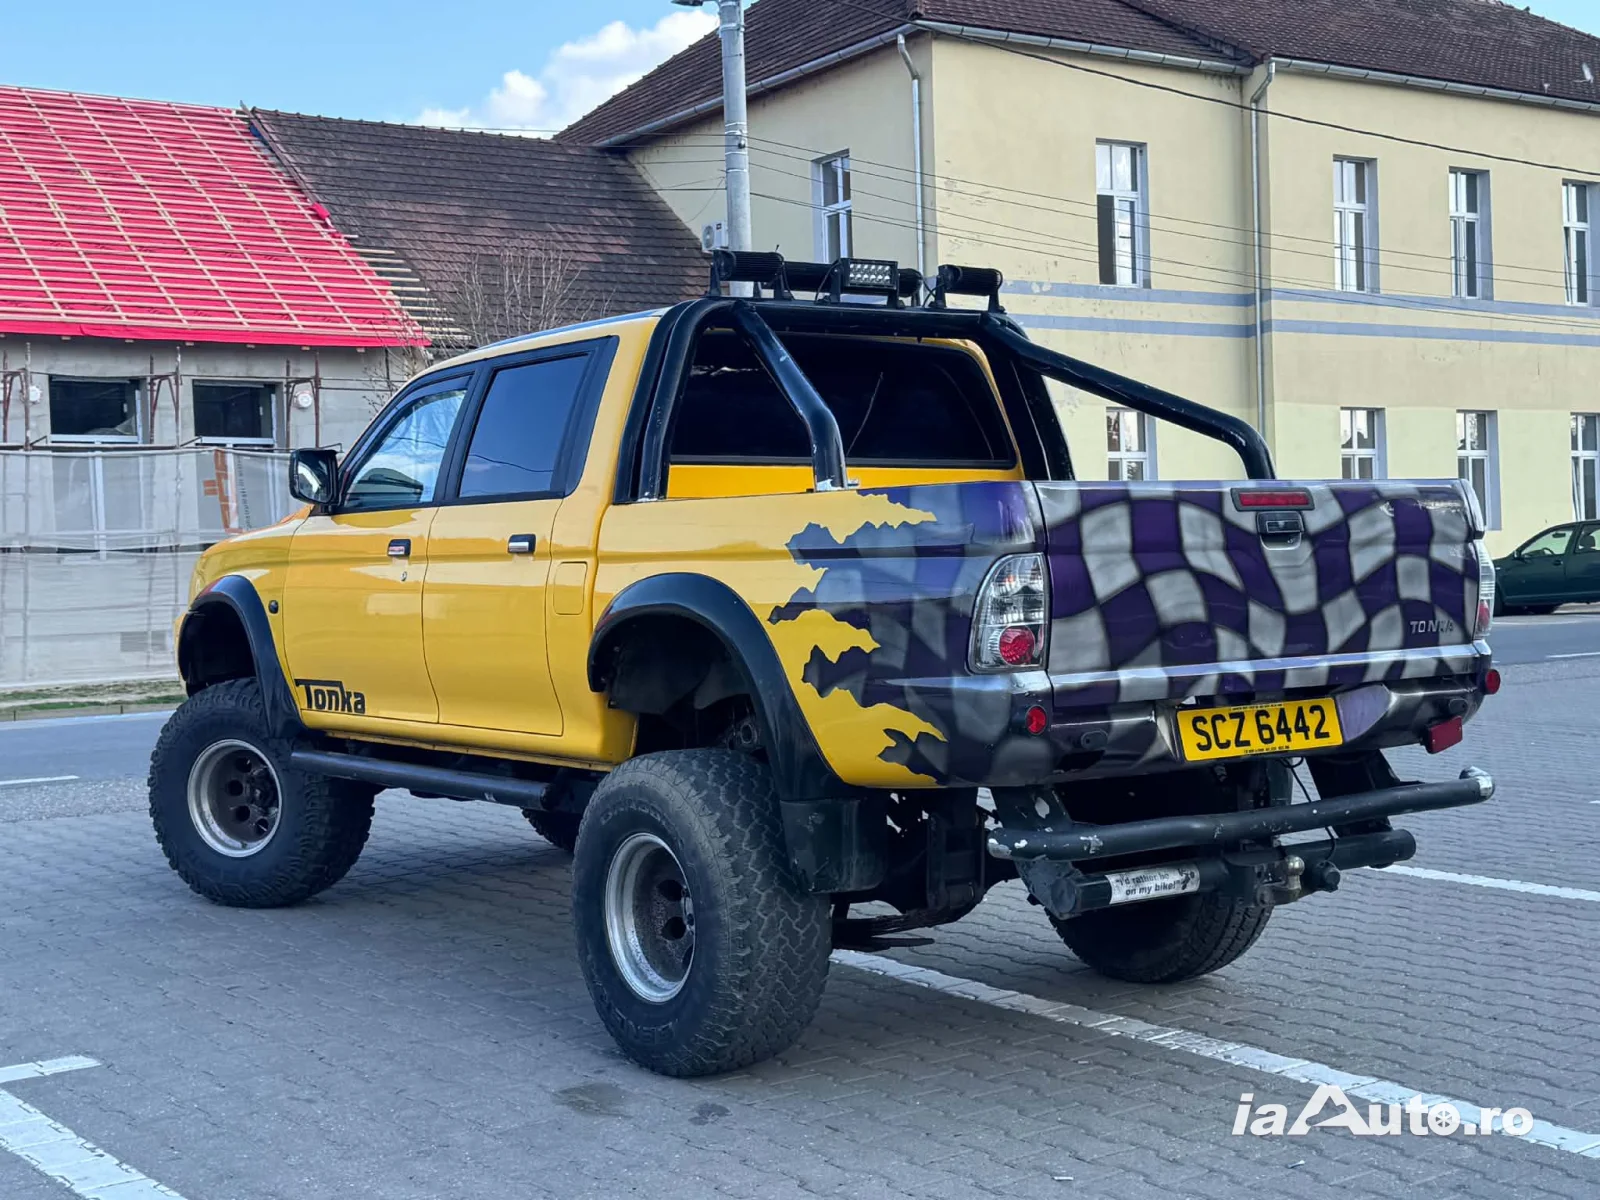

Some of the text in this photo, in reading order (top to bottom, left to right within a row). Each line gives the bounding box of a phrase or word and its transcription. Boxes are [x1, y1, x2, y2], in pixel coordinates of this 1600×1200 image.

[294, 679, 366, 714] Tonka
[1191, 704, 1330, 751] SCZ 6442
[1125, 888, 1137, 896] on
[1138, 885, 1153, 895] my
[1132, 874, 1158, 885] rather
